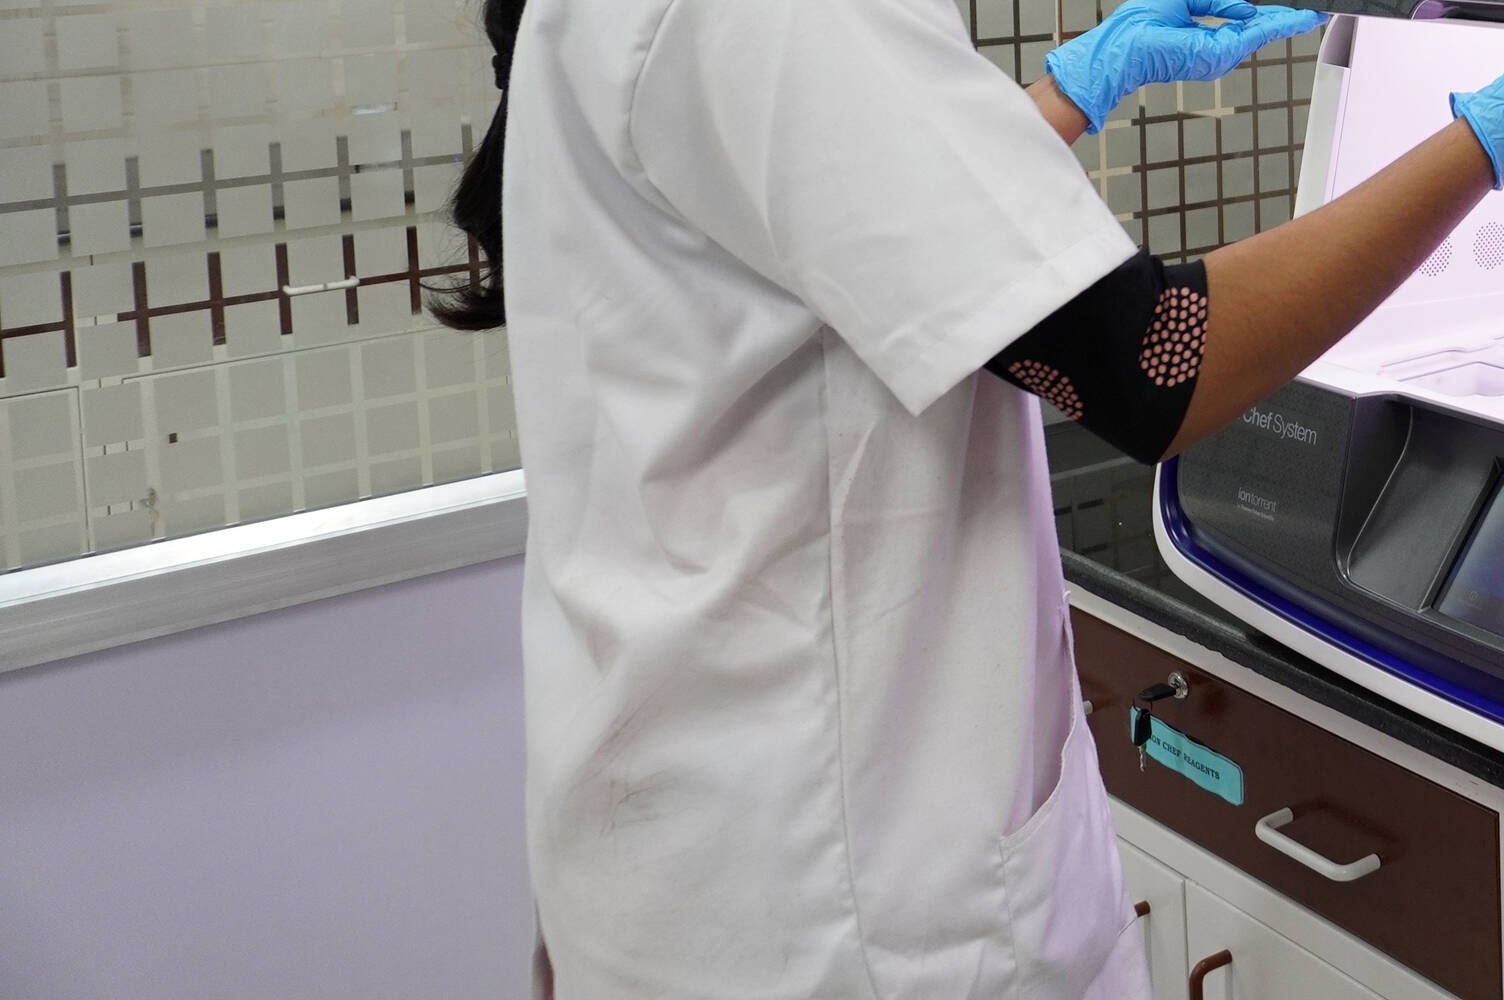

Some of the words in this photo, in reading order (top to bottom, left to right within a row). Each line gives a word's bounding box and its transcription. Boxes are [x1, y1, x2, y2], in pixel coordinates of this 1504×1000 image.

[1272, 414, 1317, 445] System
[1151, 735, 1161, 746] ON
[1162, 742, 1181, 757] CHEF
[1183, 753, 1220, 780] REAGENTS
